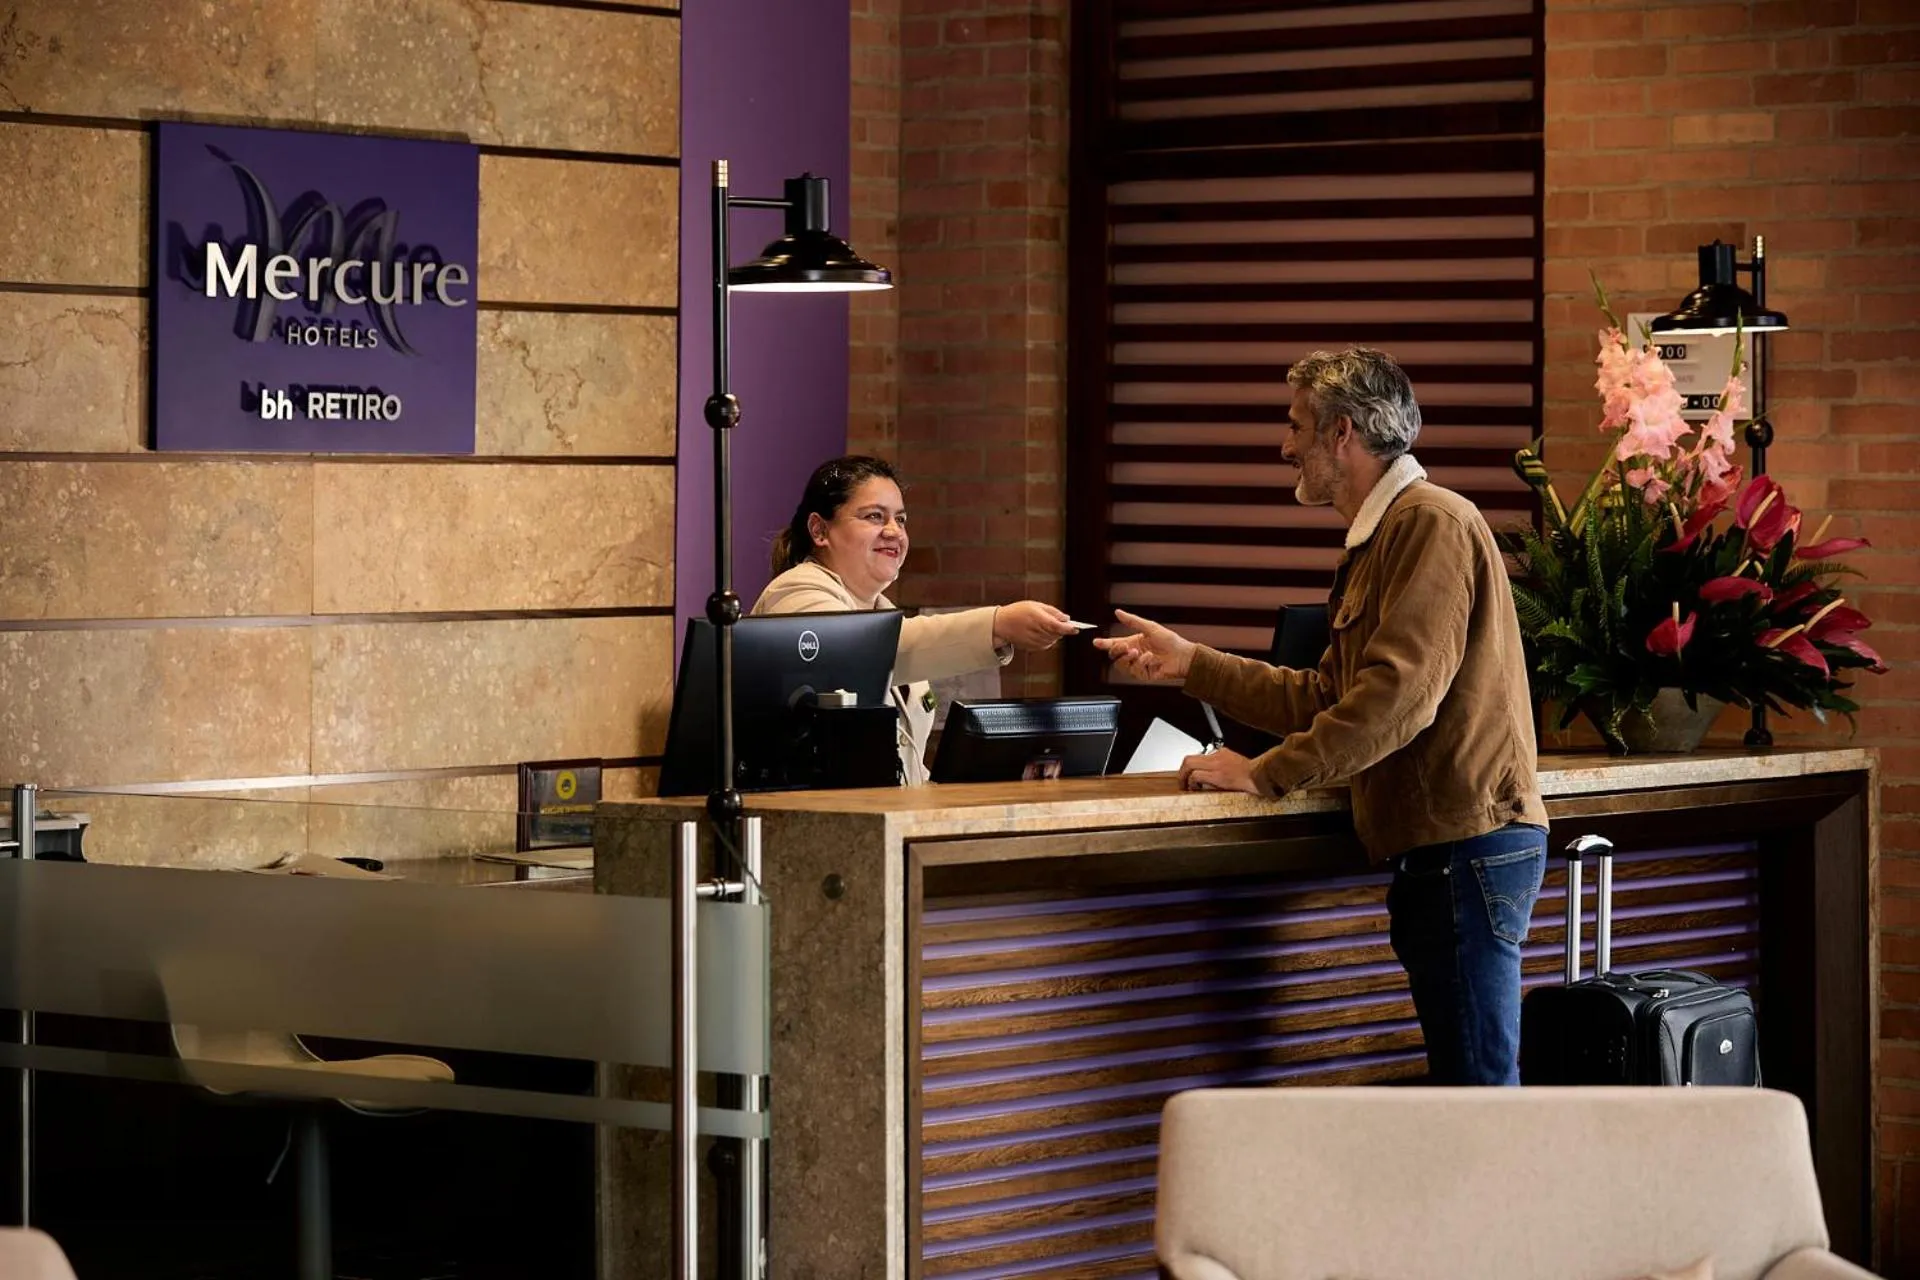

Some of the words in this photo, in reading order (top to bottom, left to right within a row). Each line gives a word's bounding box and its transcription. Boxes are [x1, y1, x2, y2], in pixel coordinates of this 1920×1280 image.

[205, 242, 469, 306] Mercure
[287, 326, 379, 349] HOTELS
[261, 389, 293, 420] bh
[308, 392, 402, 421] RETIRO
